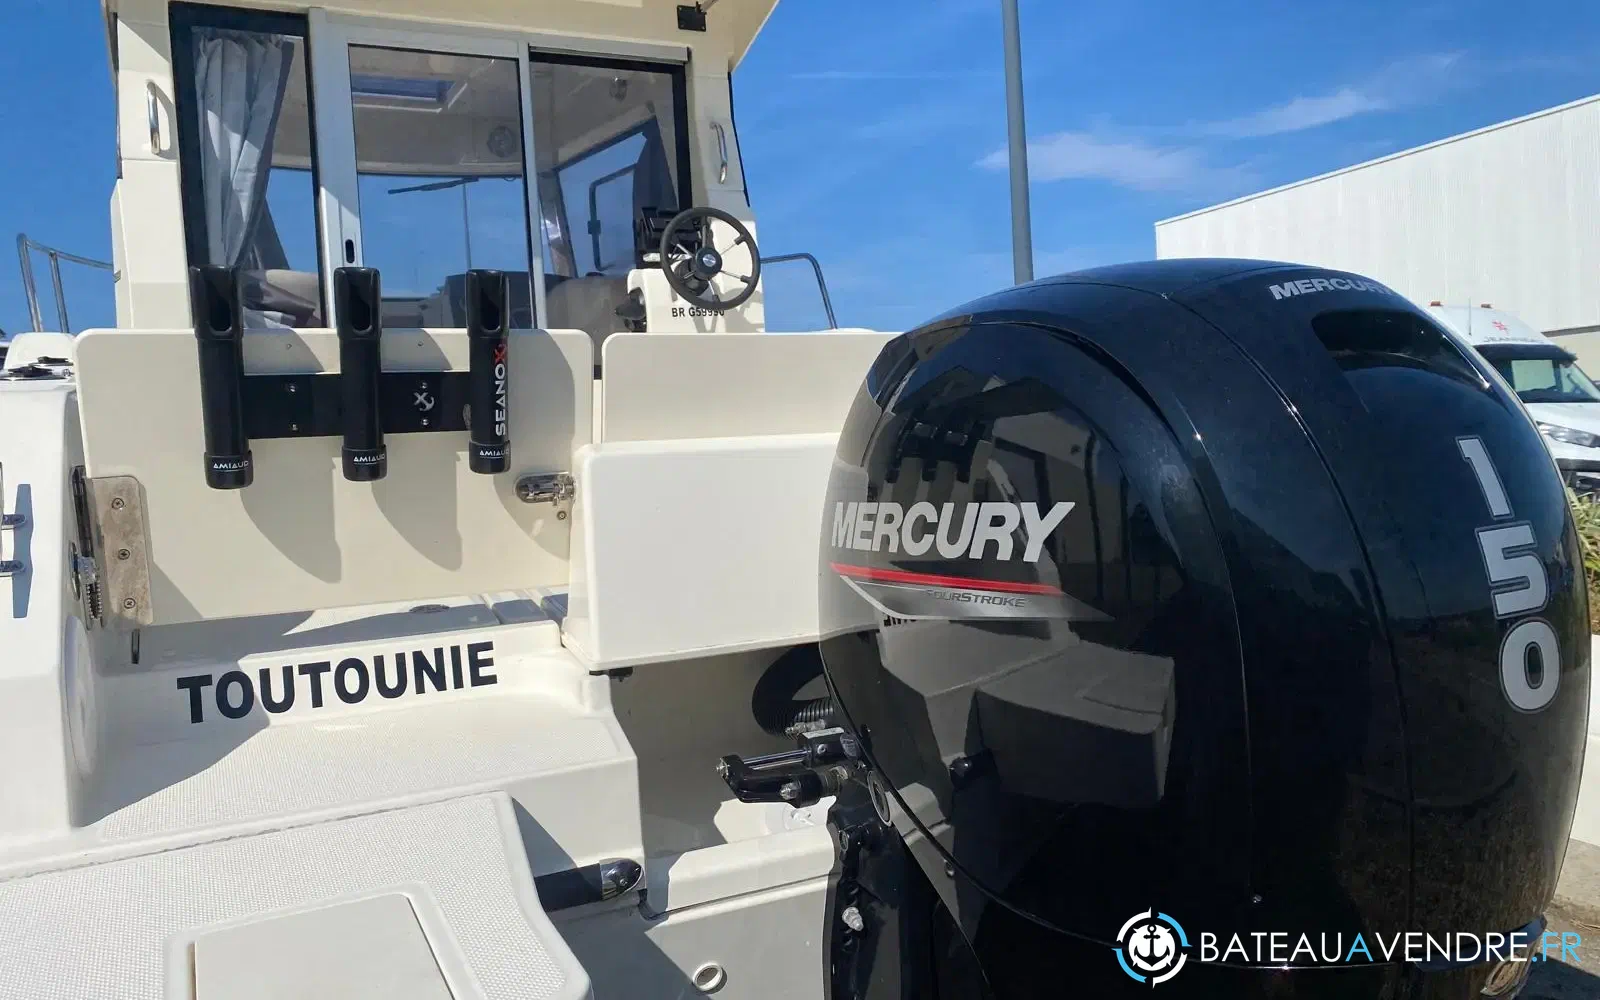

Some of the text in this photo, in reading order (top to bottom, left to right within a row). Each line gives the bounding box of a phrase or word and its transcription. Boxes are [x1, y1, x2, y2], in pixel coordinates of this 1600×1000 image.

[671, 307, 685, 318] BR
[831, 501, 1075, 563] MERCURY
[926, 589, 1026, 608] FOURSTROKE
[1455, 435, 1562, 714] 150
[177, 640, 498, 724] TOUTOUNIE
